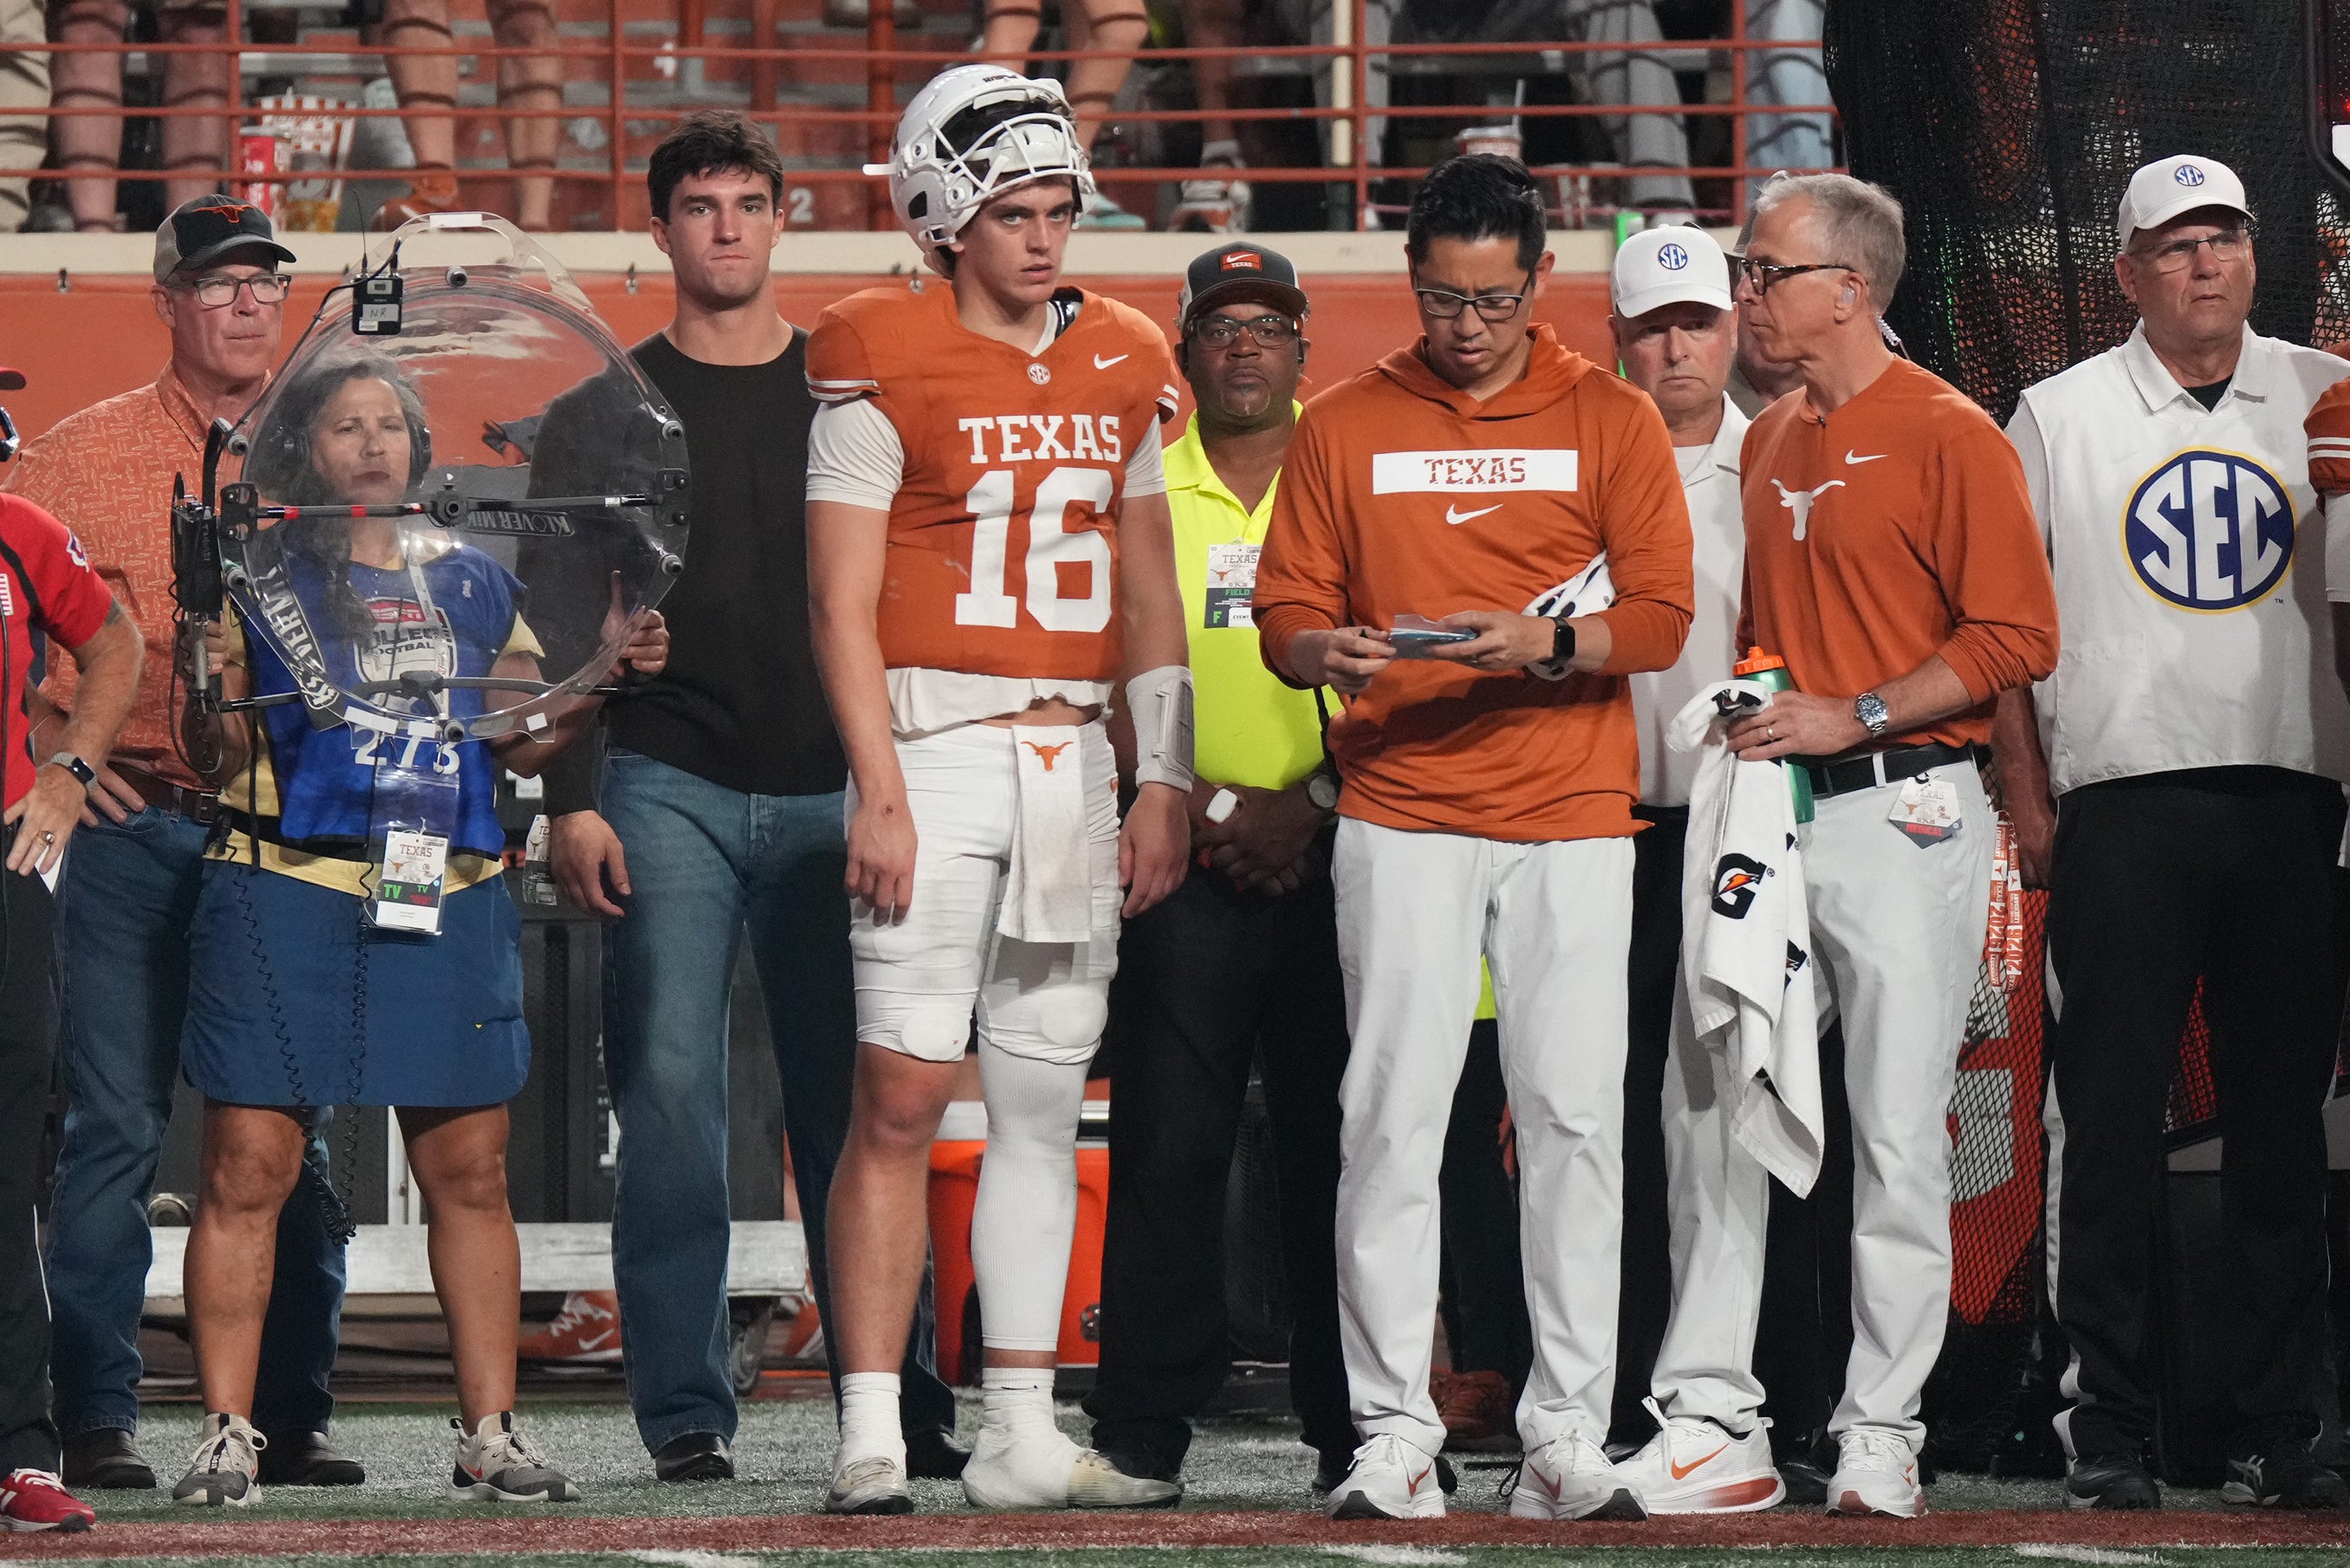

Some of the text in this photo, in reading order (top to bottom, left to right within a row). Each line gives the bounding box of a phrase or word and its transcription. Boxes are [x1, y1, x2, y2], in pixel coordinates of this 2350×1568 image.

[2176, 165, 2204, 185] SEC
[789, 187, 813, 223] 2
[1659, 245, 1686, 269] SEC
[1029, 364, 1048, 383] SEC
[958, 414, 1121, 463] TEXAS
[1424, 457, 1525, 483] TEXAS
[2134, 459, 2282, 600] SEC
[955, 466, 1113, 633] 16
[1222, 554, 1257, 564] TEXAS
[1213, 611, 1222, 623] F
[1906, 823, 1944, 837] MEDICAL
[399, 844, 432, 858] TEXAS
[384, 884, 429, 899] TV TV
[2006, 925, 2023, 975] 2026
